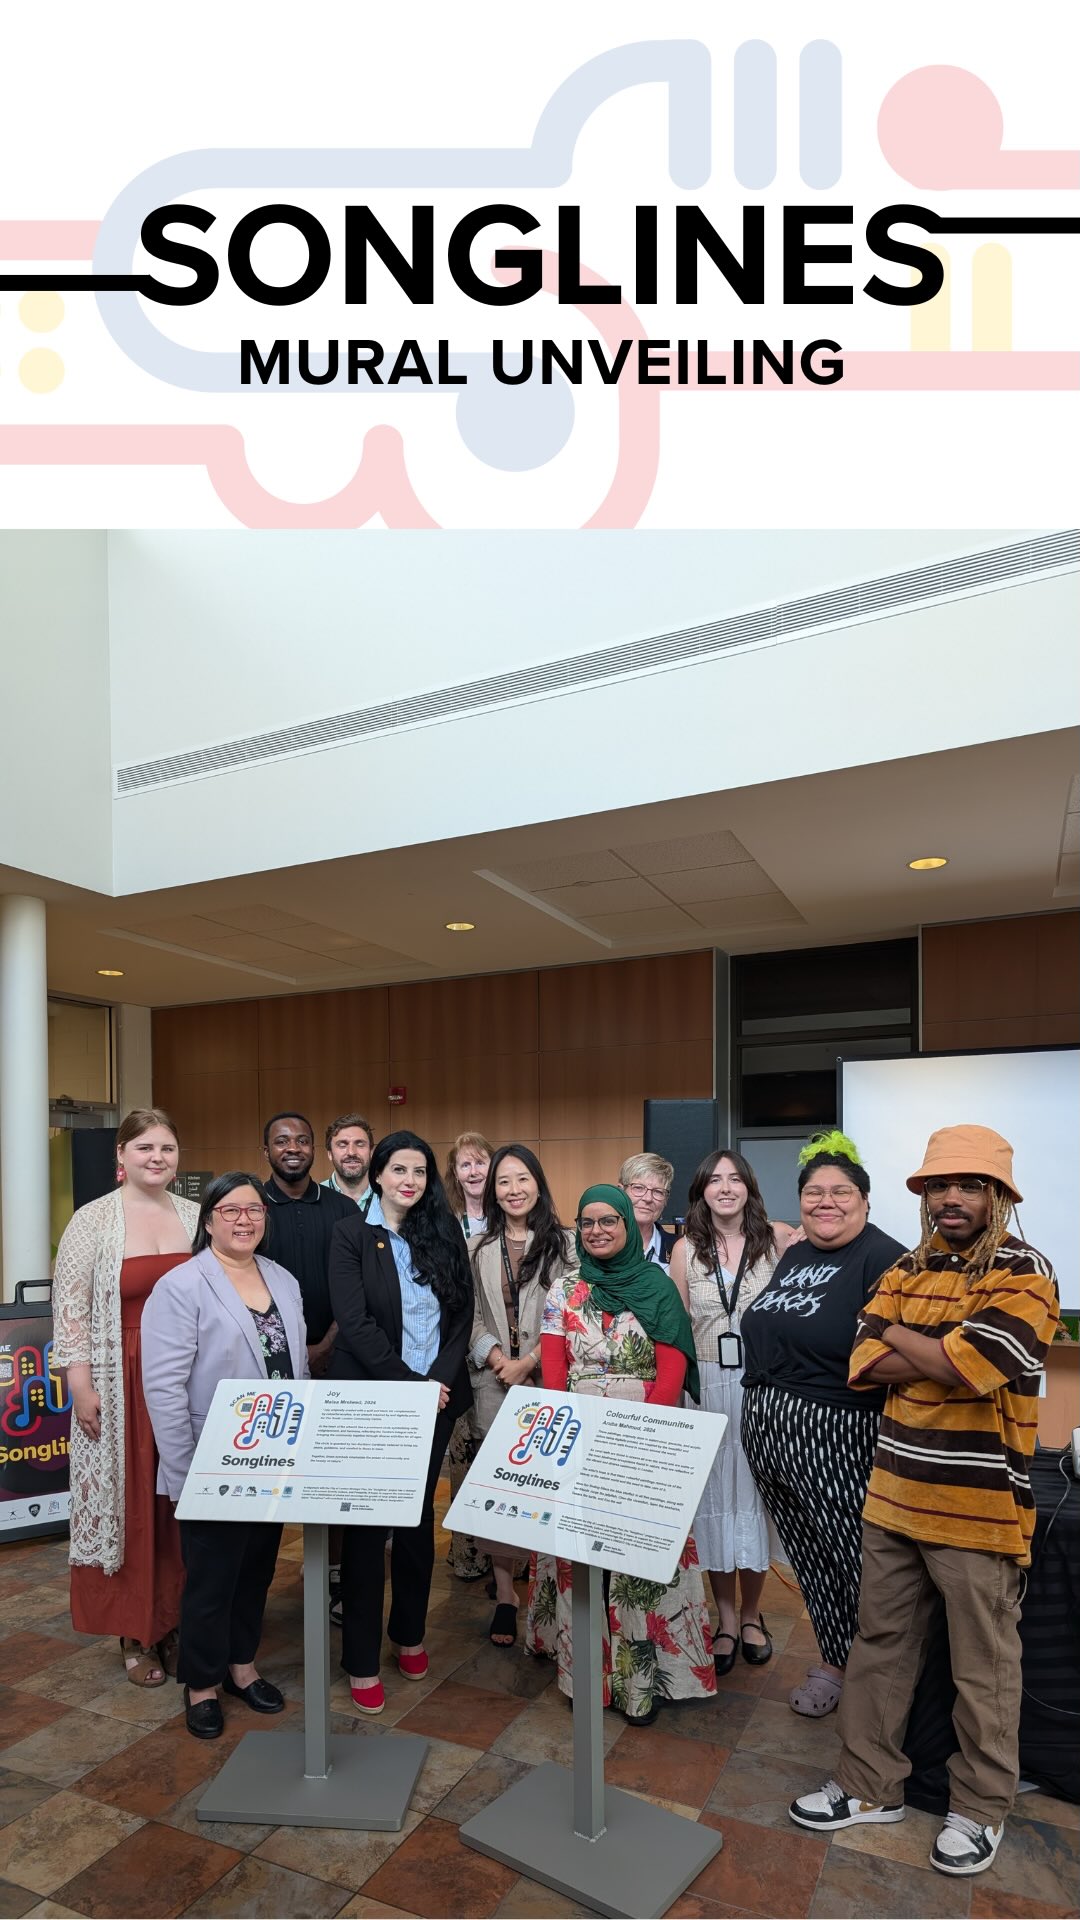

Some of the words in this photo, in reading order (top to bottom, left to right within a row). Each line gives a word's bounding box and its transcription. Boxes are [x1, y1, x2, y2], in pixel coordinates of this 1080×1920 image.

[780, 1263, 842, 1289] LAND
[751, 1289, 827, 1317] BACK
[230, 1394, 245, 1407] SCAN
[514, 1403, 530, 1416] SCAN
[606, 1410, 641, 1421] Colourful
[642, 1416, 695, 1430] Communities
[221, 1455, 295, 1469] Songlines
[493, 1467, 560, 1491] Songlines
